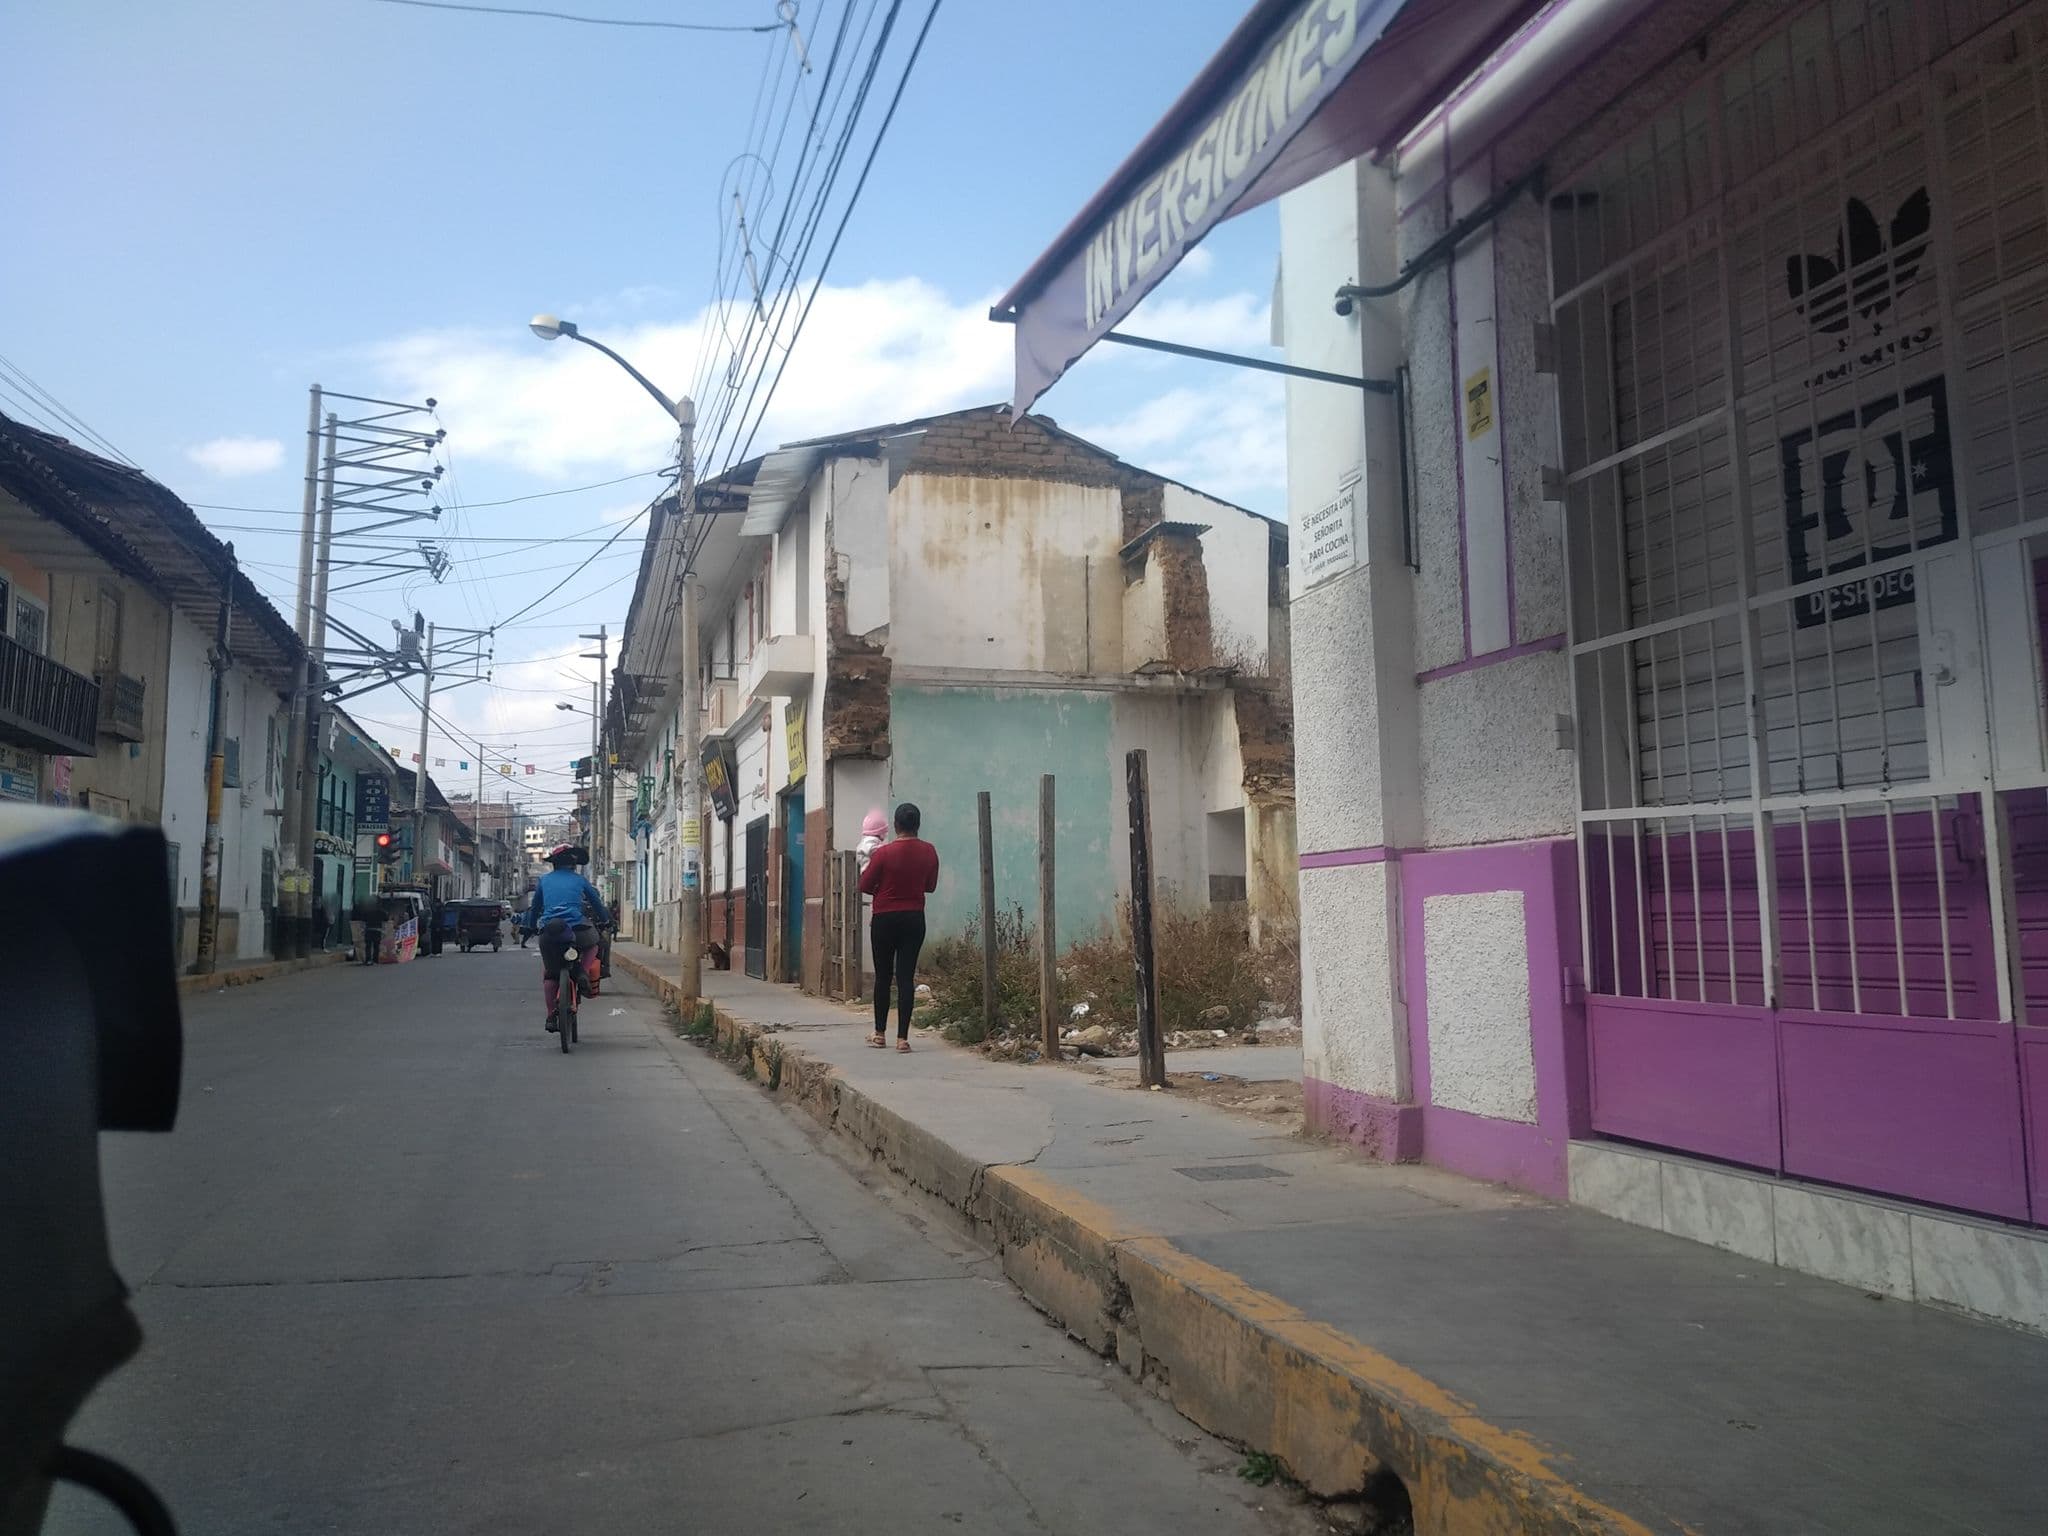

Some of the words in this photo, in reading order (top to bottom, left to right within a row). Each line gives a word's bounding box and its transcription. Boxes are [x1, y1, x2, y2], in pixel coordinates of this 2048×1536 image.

[1085, 0, 1358, 331] INVERSIONES
[1311, 503, 1338, 526] NECESITA
[1314, 518, 1343, 543] SEÑORITA
[1324, 533, 1349, 554] COCINA
[365, 779, 381, 822] HOTEL
